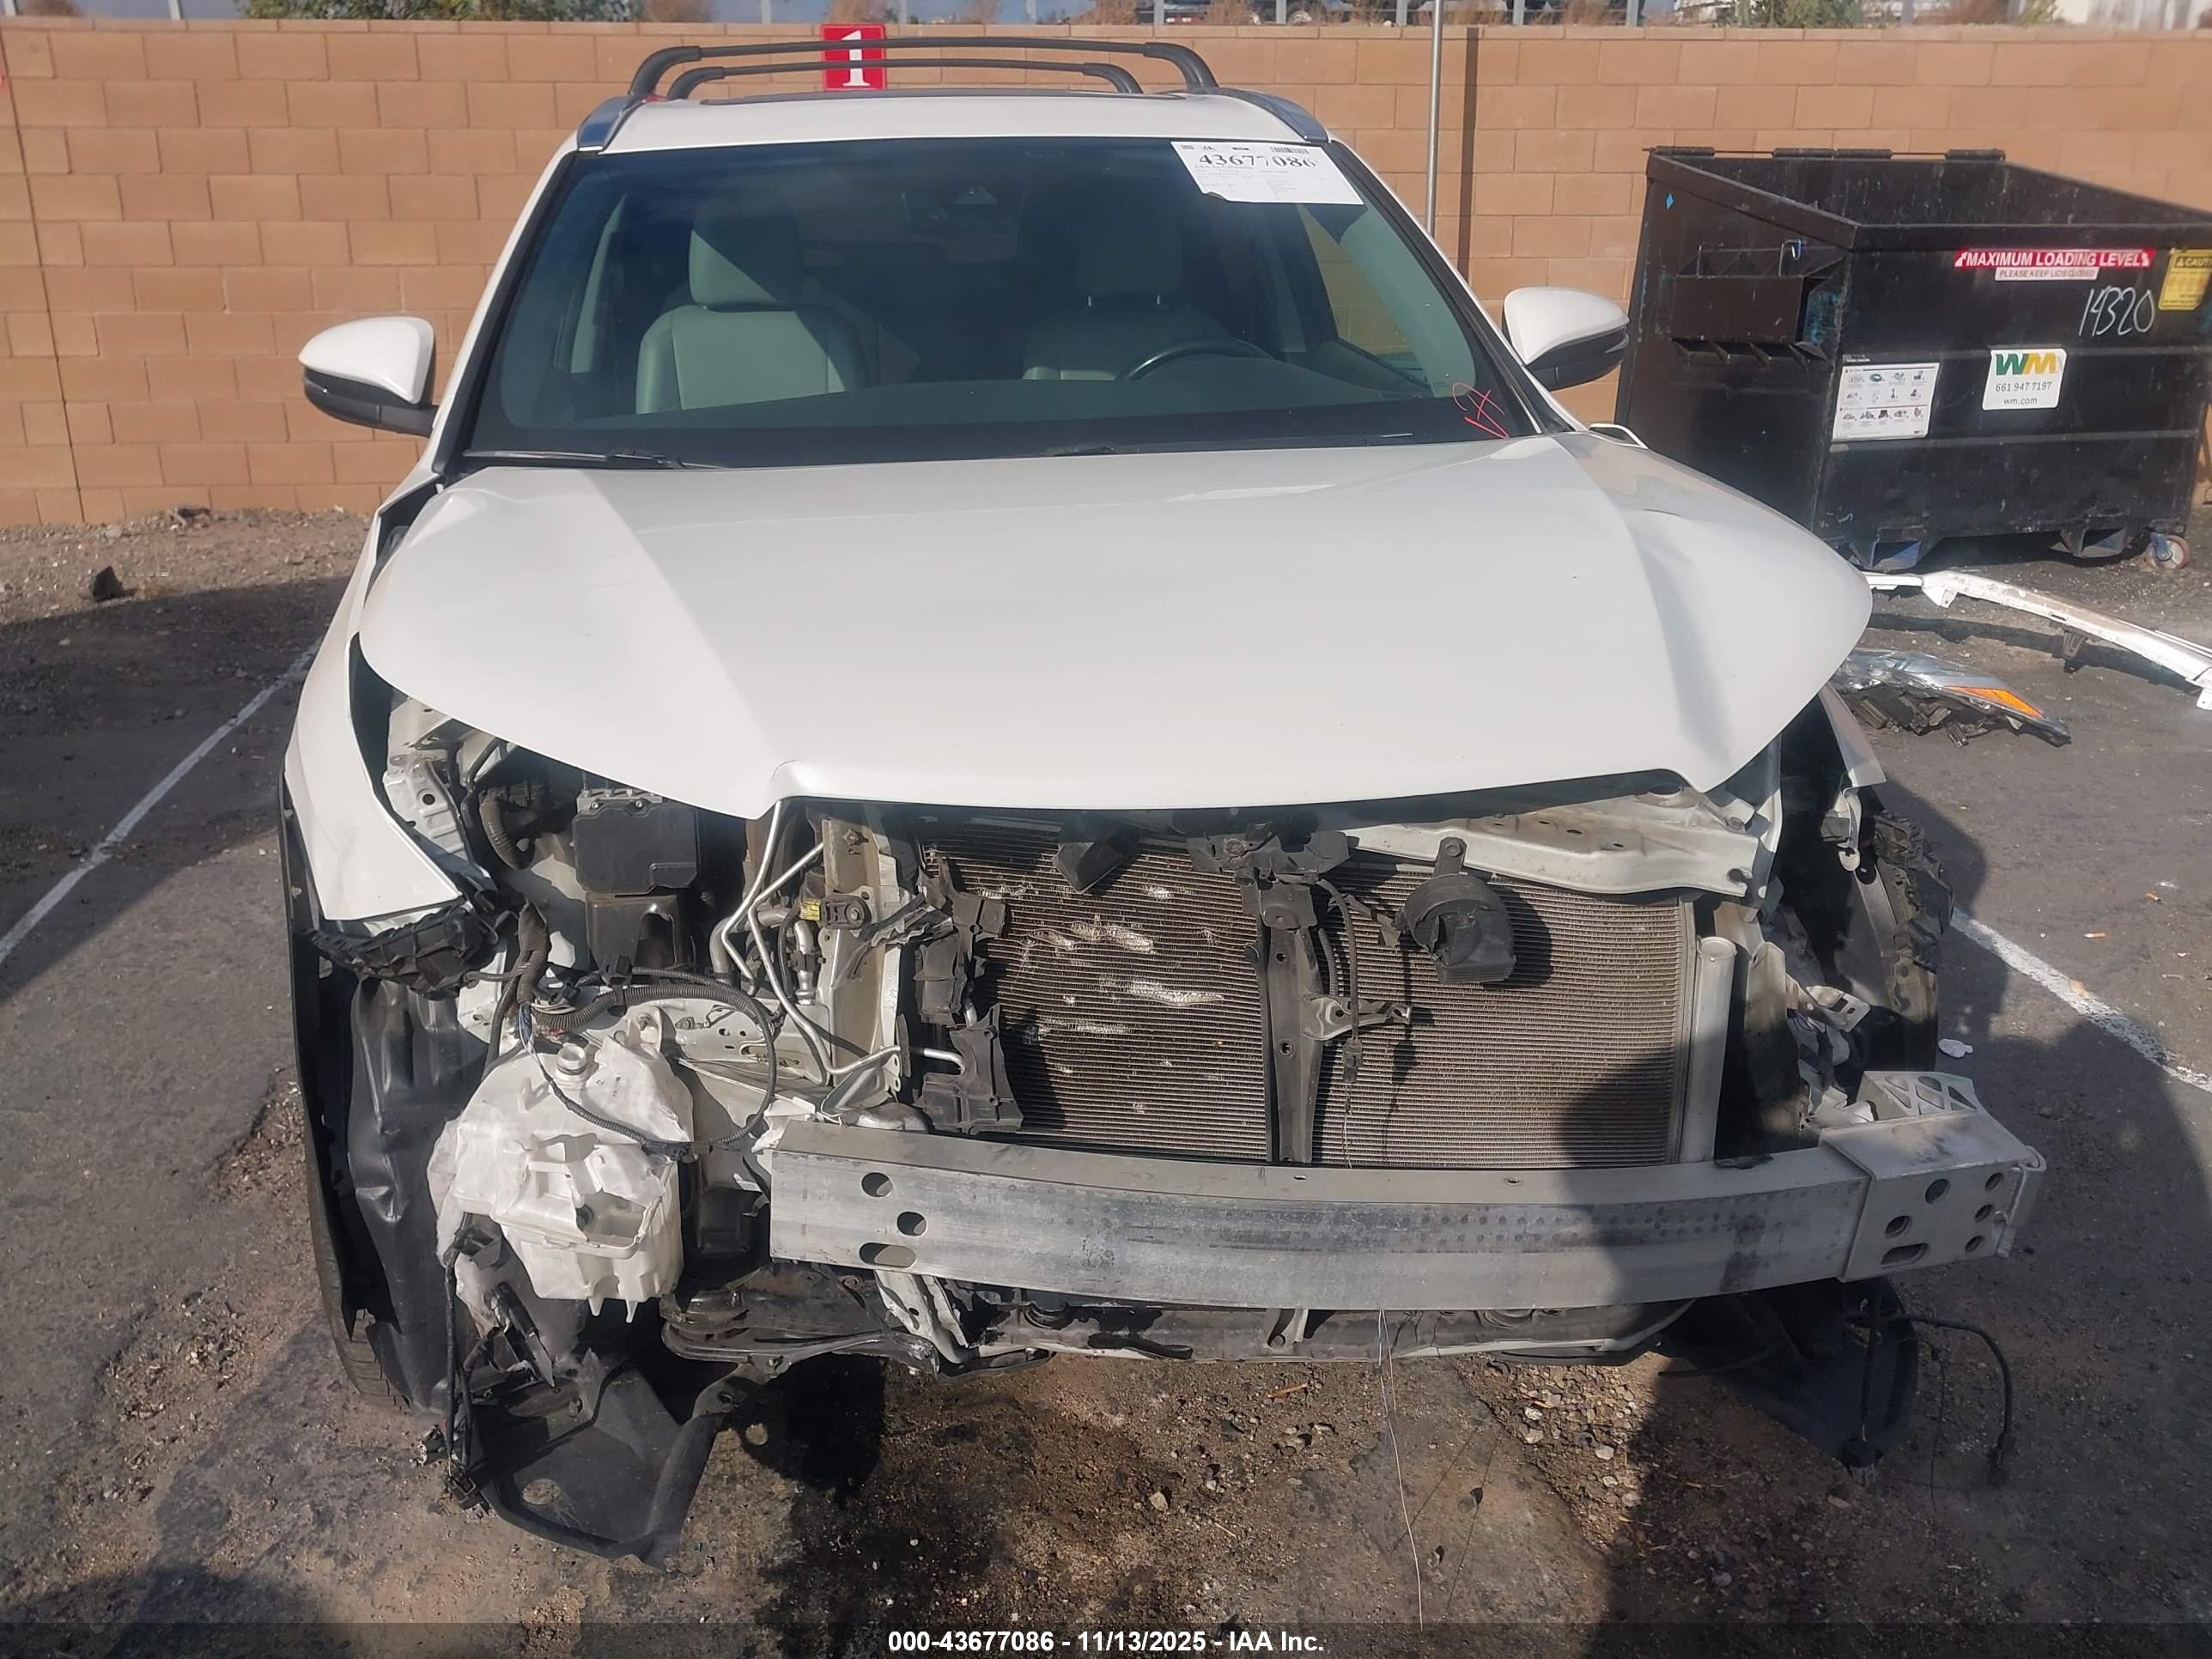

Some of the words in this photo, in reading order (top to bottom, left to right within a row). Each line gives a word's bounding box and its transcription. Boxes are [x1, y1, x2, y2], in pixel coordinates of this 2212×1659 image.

[841, 30, 871, 86] 1
[1199, 155, 1318, 167] 43677086
[1966, 252, 2033, 266] MAXIMUM
[2036, 252, 2096, 266] LOADING
[2099, 252, 2141, 266] LEVEL
[2079, 285, 2156, 337] 14320
[1996, 353, 2057, 375] WM
[1996, 383, 2011, 392] 661
[2014, 382, 2031, 392] 947
[2032, 381, 2052, 391] 7197
